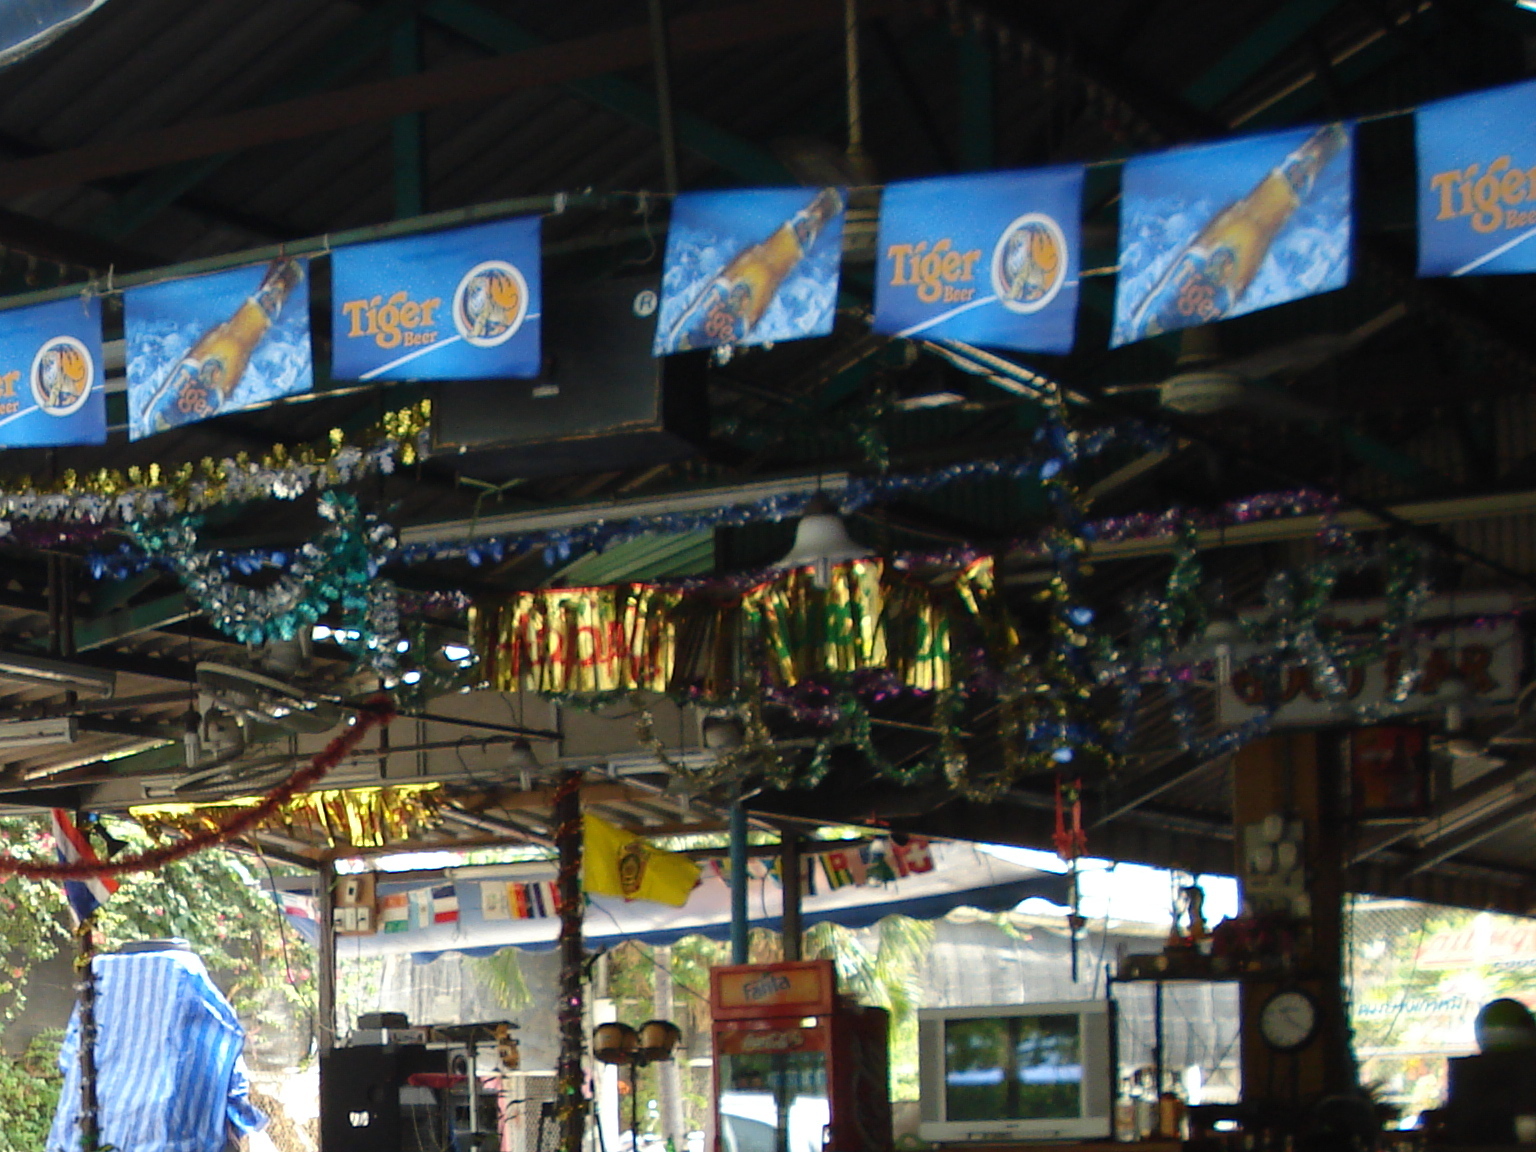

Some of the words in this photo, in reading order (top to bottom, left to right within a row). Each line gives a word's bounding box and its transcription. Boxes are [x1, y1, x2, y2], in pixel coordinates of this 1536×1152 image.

[1506, 209, 1536, 230] Bee
[887, 238, 981, 303] Tiger
[944, 286, 976, 303] Beer
[342, 292, 442, 349] Tiger
[403, 329, 438, 347] Beer
